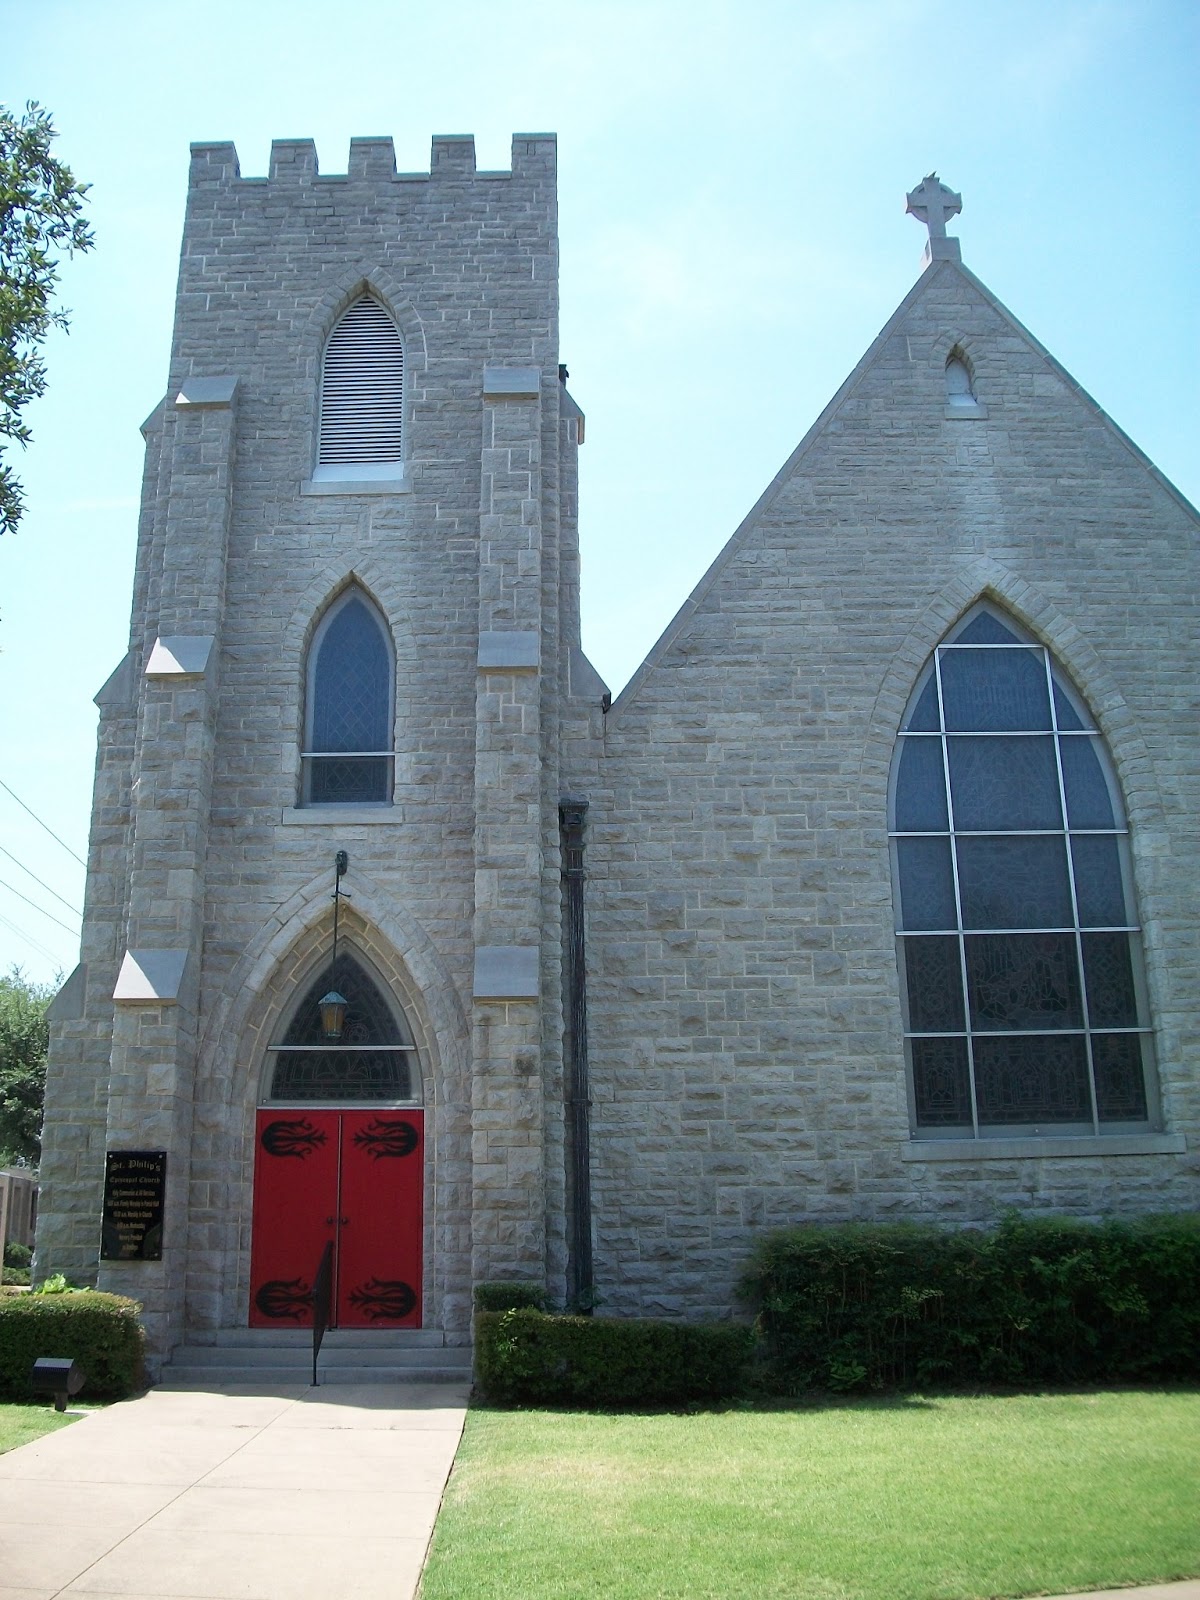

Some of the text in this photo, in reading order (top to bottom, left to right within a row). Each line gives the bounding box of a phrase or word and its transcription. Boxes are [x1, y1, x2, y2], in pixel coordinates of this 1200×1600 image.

[110, 1159, 161, 1172] St. Philip's
[109, 1176, 161, 1184] Episcopal Church
